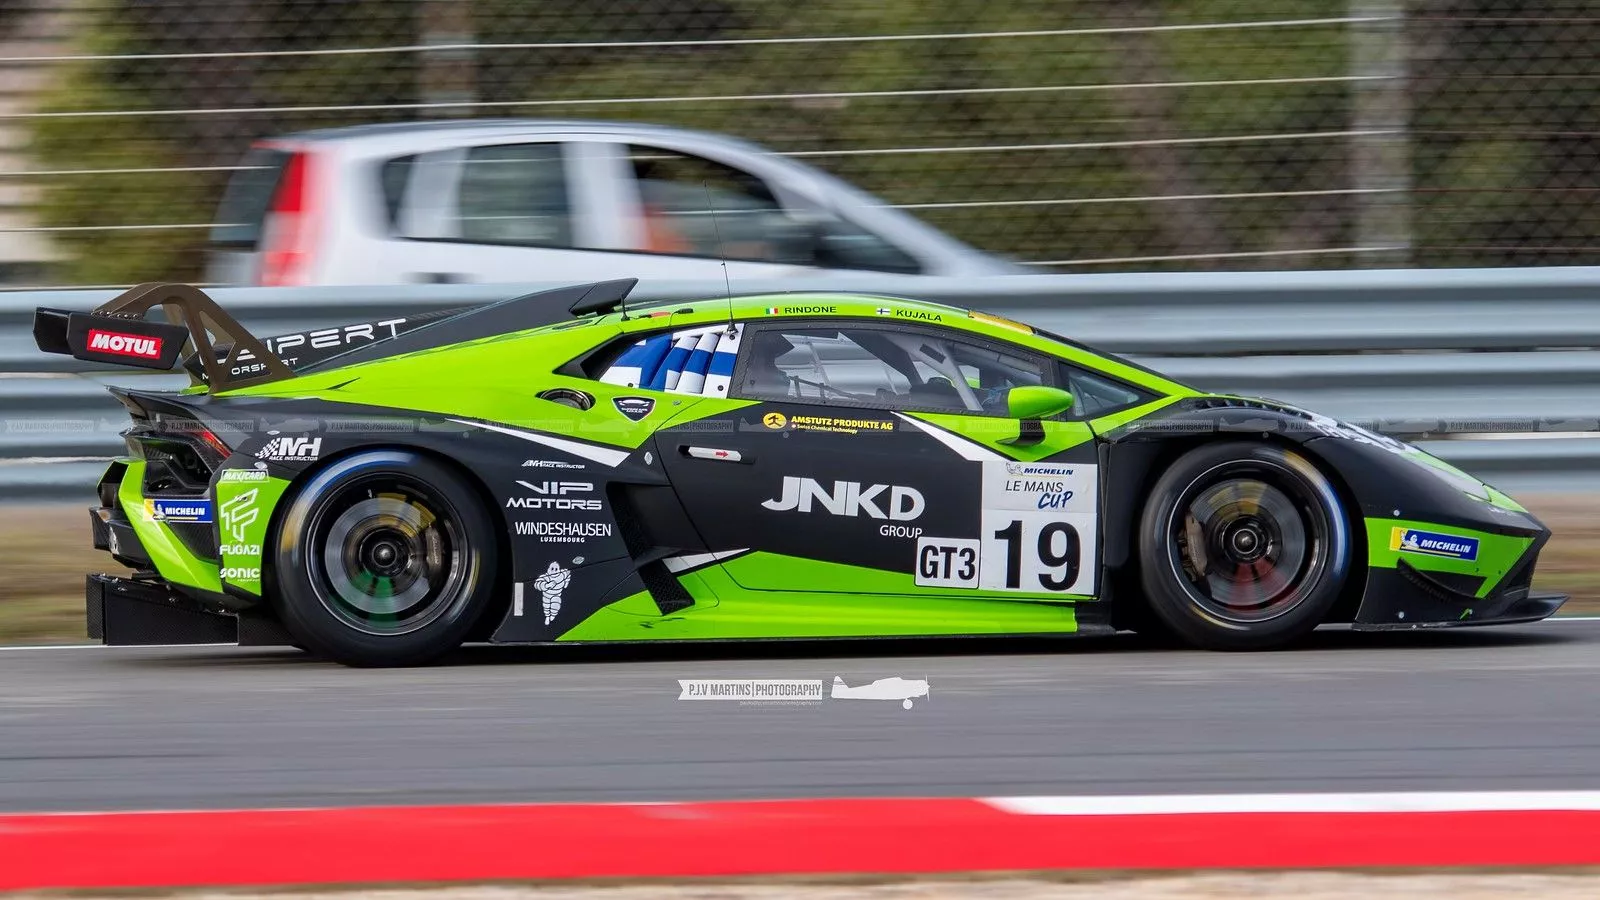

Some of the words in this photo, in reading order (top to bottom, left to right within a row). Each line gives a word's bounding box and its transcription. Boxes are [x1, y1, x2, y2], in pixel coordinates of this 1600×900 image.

[784, 306, 837, 314] RINDONE
[896, 309, 942, 322] KUJALA
[91, 333, 157, 355] MOTUL
[791, 415, 832, 426] AMSTUTZ
[833, 418, 879, 429] PRODUKTE
[880, 421, 893, 431] AG
[278, 437, 322, 456] MH
[1024, 467, 1073, 475] MICHELIN
[516, 480, 593, 494] VIP
[1005, 480, 1021, 491] LE
[1024, 481, 1064, 493] MANS
[506, 497, 602, 510] MOTORS
[761, 476, 925, 521] JNKD
[1038, 491, 1073, 509] CUP
[165, 507, 205, 515] MICHELIN
[515, 521, 611, 537] WINDESHAUSEN
[880, 524, 922, 539] GROUP
[219, 544, 260, 555] FUGAZI
[1420, 539, 1471, 553] MICHELIN
[919, 544, 976, 580] GT3
[994, 519, 1081, 591] 19
